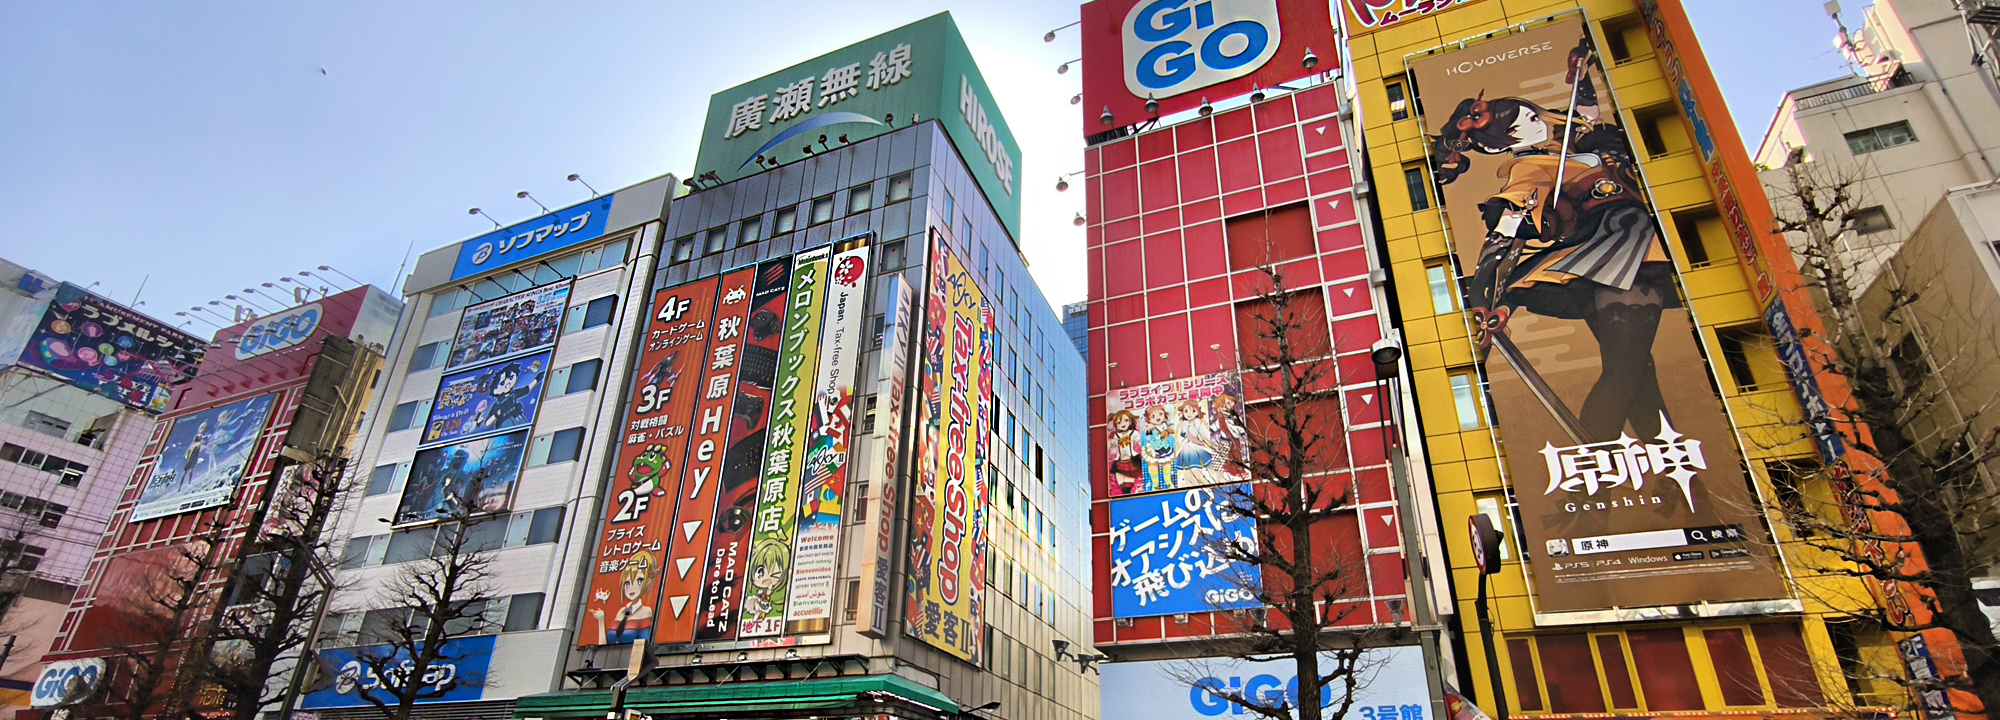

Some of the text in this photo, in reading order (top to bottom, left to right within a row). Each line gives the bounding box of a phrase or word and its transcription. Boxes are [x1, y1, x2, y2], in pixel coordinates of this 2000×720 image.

[1135, 19, 1270, 90] GO
[1445, 41, 1553, 76] HOYOVERSE
[723, 43, 914, 140] 廣瀬無線
[958, 73, 1014, 197] HIROSE
[499, 210, 592, 256] ソフマップ
[656, 296, 691, 322] 4F
[160, 327, 185, 341] PARK
[648, 331, 703, 352] オンラインゲーム
[651, 318, 705, 340] カードゲーム
[829, 326, 846, 367] Tax-free
[826, 367, 841, 395] Shop
[636, 384, 671, 415] 3F
[689, 315, 742, 500] 秋葉原 Hey
[757, 267, 816, 534] メロンブックス秋葉原店
[627, 425, 685, 445] 麻雀・パズル
[630, 414, 669, 430] 対戦格闘
[885, 376, 904, 481] Tax-free
[1537, 410, 1708, 514] 原神
[611, 490, 650, 524] 2F
[1564, 494, 1662, 513] Genshin
[878, 482, 896, 554] Shop
[606, 525, 647, 542] プライズ
[800, 534, 834, 544] Welcome
[1580, 538, 1609, 551] 原神
[602, 539, 662, 558] レトロゲーム
[599, 555, 649, 574] 音楽ゲーム
[796, 566, 832, 575] Bienvenidos
[1564, 555, 1668, 569] PS5 PS4 Windows
[706, 548, 726, 628] Dare to Lead
[718, 541, 738, 633] MAD CATZ
[1205, 587, 1255, 604] GiGO
[793, 599, 828, 607] Bienvenue
[793, 607, 823, 617] accueillir
